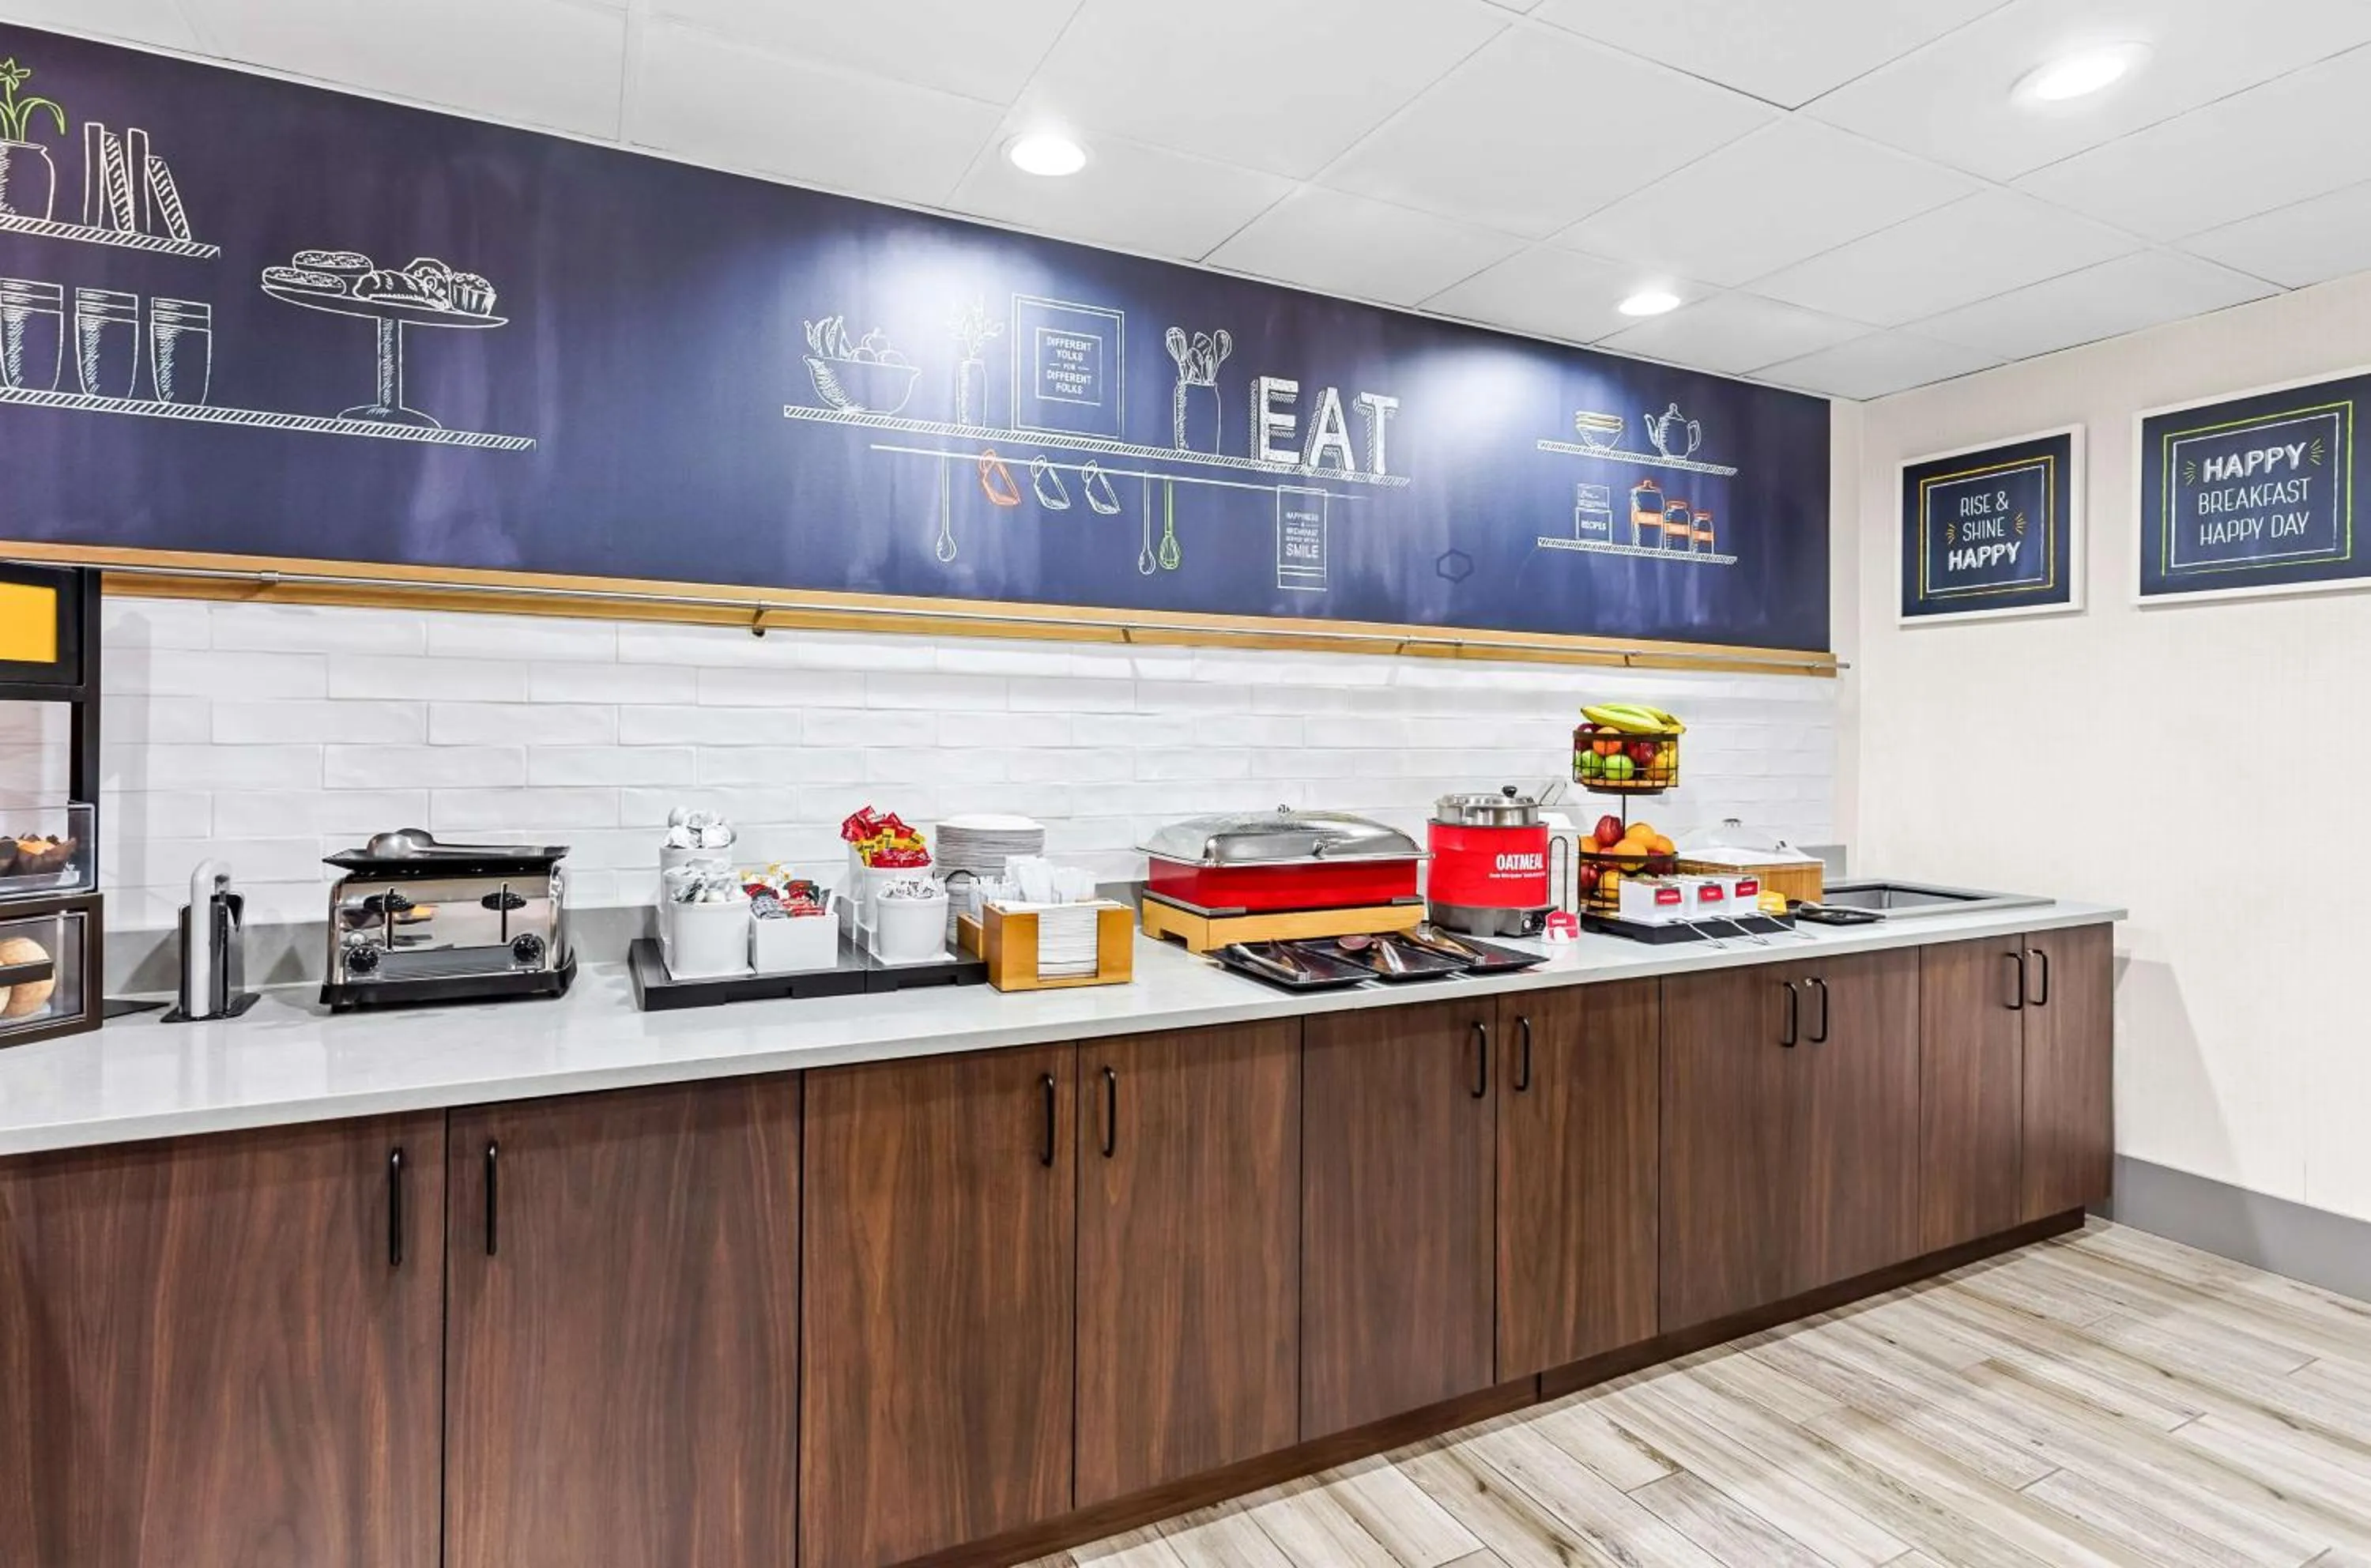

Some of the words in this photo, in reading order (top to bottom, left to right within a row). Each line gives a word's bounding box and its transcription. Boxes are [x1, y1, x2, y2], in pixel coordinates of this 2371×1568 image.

[1046, 336, 1092, 352] DIFFERENT
[1056, 349, 1084, 362] YOLKS
[1046, 369, 1091, 385] DIFFERENT
[1056, 383, 1084, 394] FOLKS
[1250, 375, 1400, 475] EAT
[2203, 442, 2306, 483] HAPPY
[1960, 492, 1992, 517] RISE
[1996, 491, 2009, 511] &
[2199, 477, 2312, 516] BREAKFAST
[1962, 516, 2005, 541] SHINE
[2199, 516, 2264, 546] HAPPY
[2271, 511, 2310, 538] DAY
[1286, 543, 1319, 558] SMILE
[1948, 541, 2021, 572] HAPPY
[1495, 853, 1544, 871] OATMEAL
